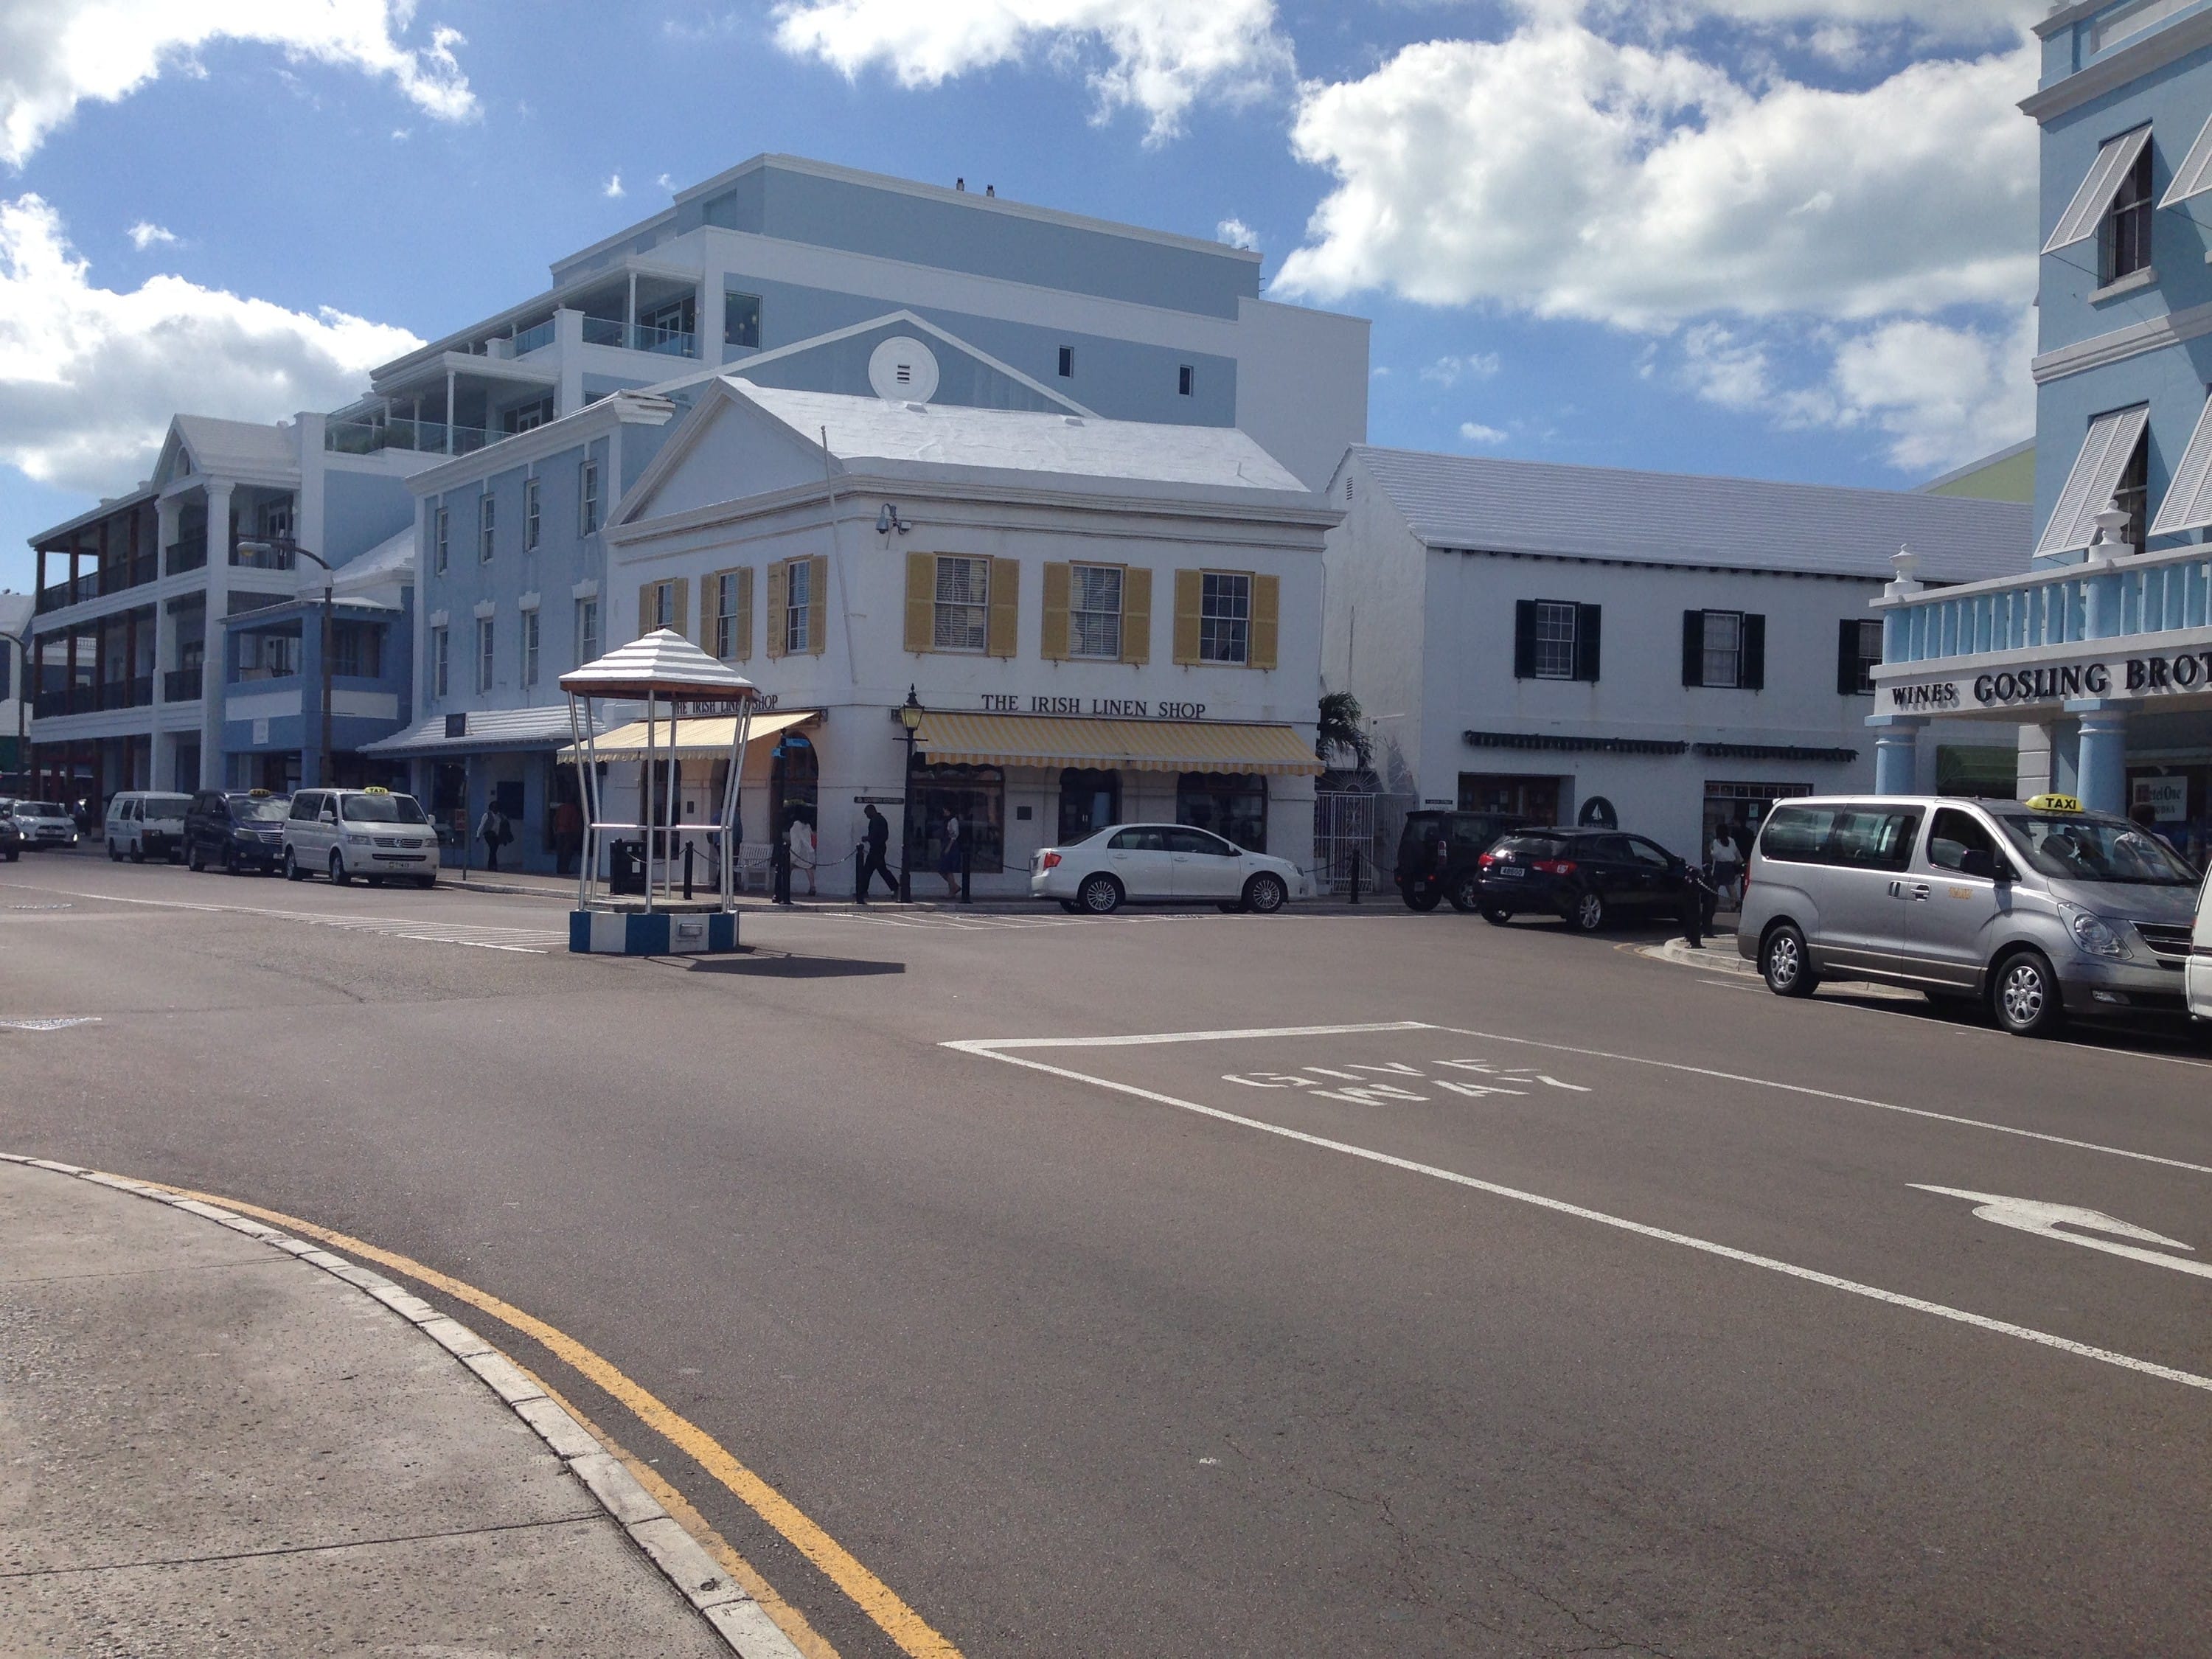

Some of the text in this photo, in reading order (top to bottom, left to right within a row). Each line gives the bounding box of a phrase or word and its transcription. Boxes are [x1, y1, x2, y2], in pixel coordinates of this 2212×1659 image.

[1891, 682, 1955, 706] WINES
[1974, 664, 2106, 701] GOSLING
[670, 694, 779, 714] HE IRISH LINE SHOP
[981, 694, 1206, 719] THE IRISH LINEN SHOP
[2045, 797, 2077, 810] TAXI
[1221, 1059, 1543, 1088] GIVE
[1307, 1074, 1593, 1107] WAY
